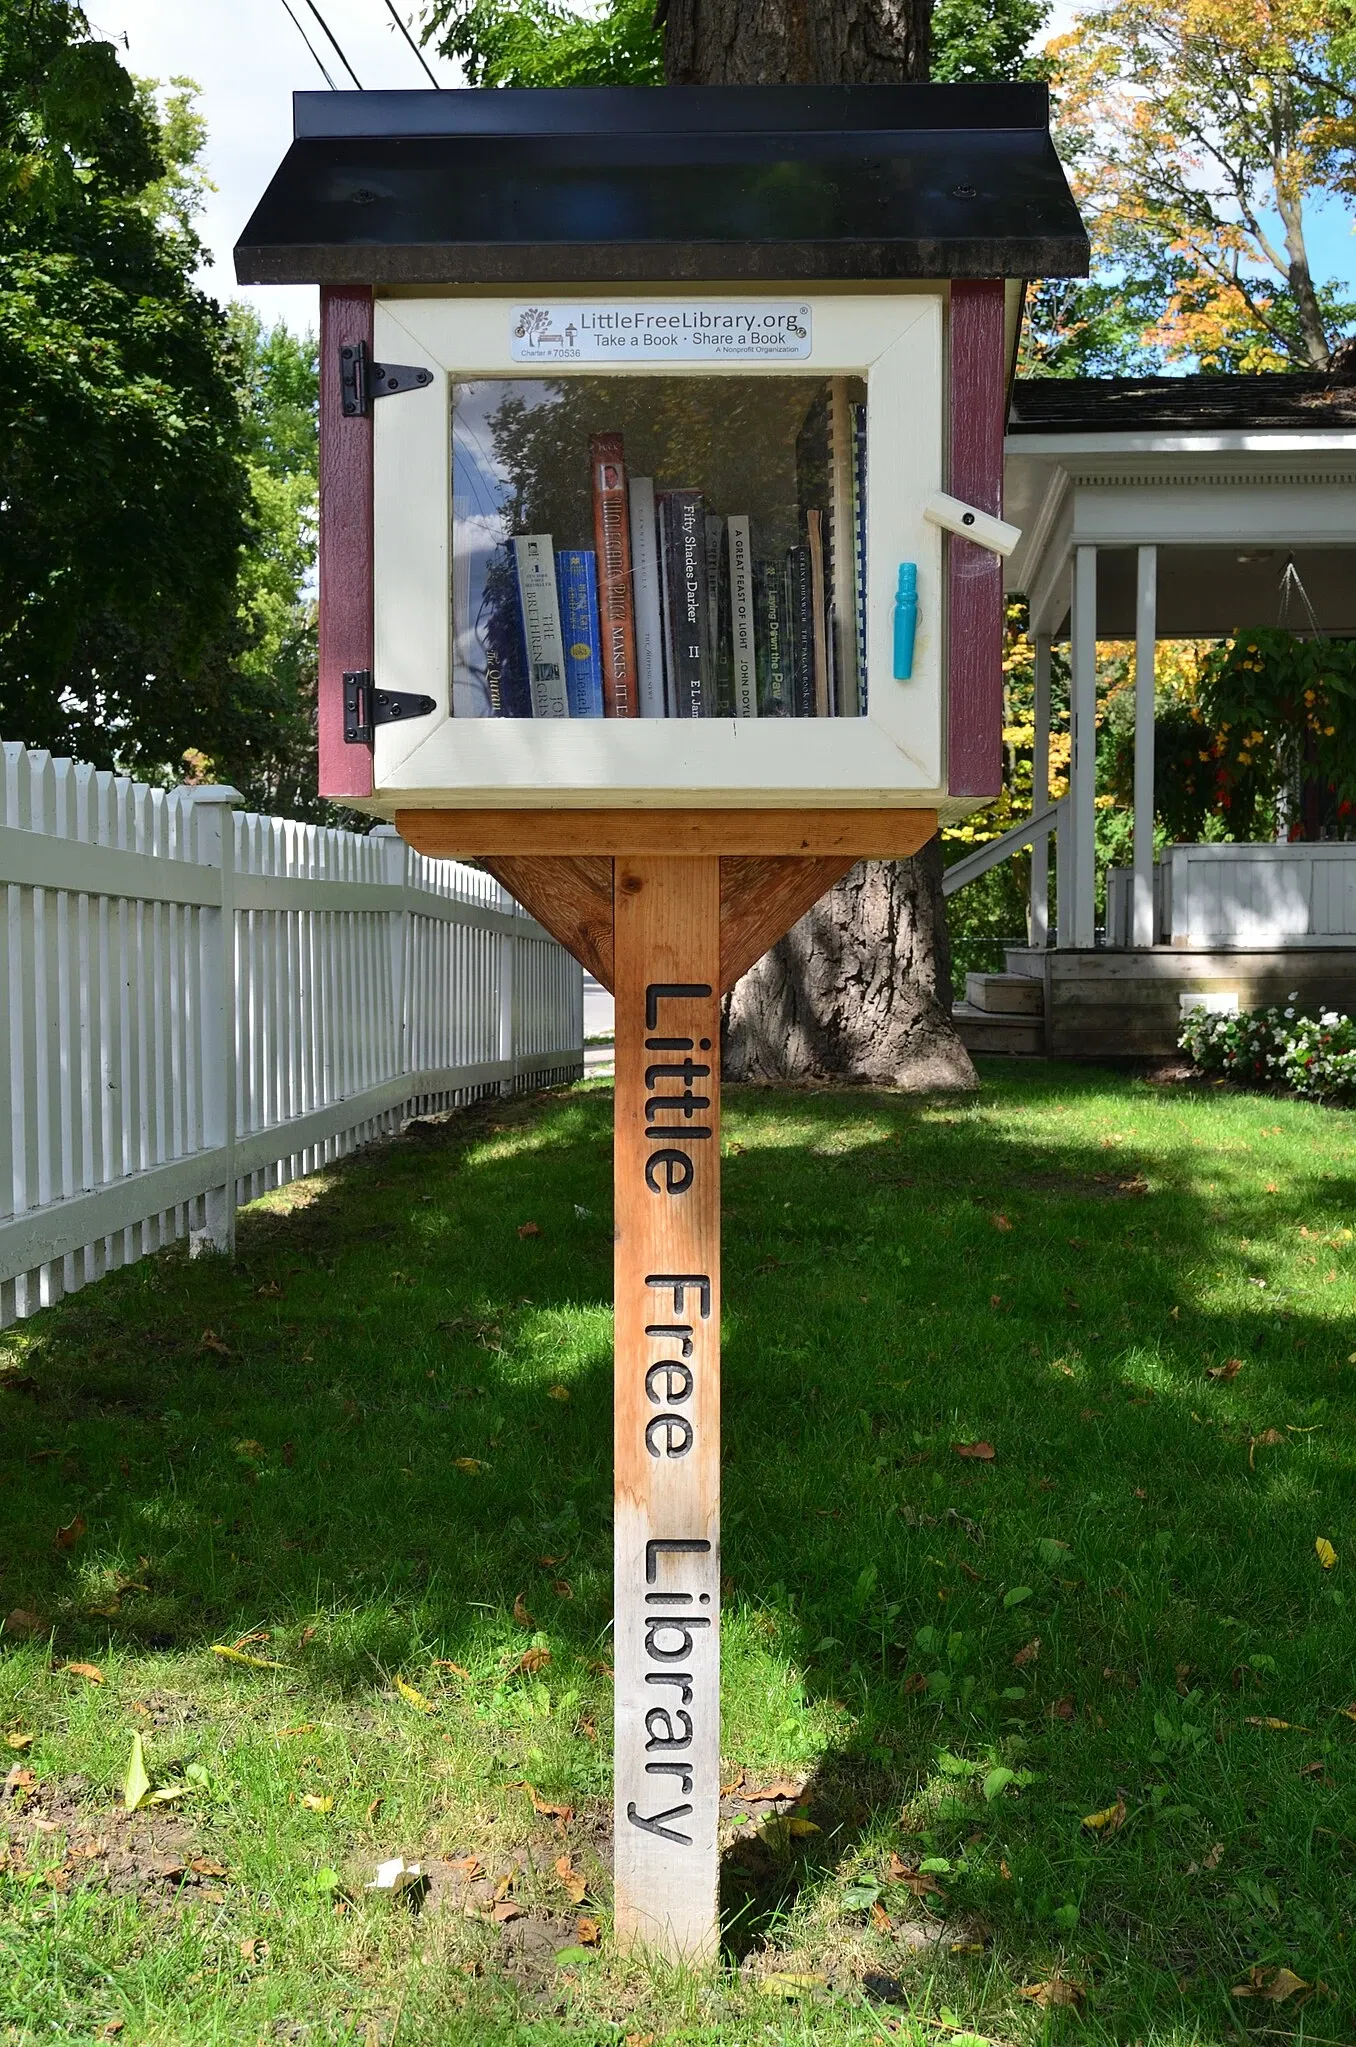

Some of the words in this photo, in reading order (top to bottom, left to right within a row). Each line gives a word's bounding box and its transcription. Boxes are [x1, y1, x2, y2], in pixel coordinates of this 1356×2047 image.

[581, 311, 798, 331] LittleFreeLibrary.org
[520, 349, 546, 357] Charter
[553, 348, 581, 358] 70536
[593, 333, 628, 346] Take
[630, 337, 639, 346] a
[643, 333, 678, 346] Book
[692, 332, 734, 345] Share
[737, 335, 746, 345] a
[751, 331, 786, 345] Book
[722, 346, 754, 354] Nonprofit
[755, 345, 799, 354] Organization
[681, 504, 696, 534] Fifty
[735, 529, 743, 537] A
[684, 535, 698, 579] Shades
[735, 540, 745, 571] GREAT
[608, 583, 626, 621] PUCK
[686, 581, 699, 624] Darker
[737, 574, 746, 603] FEAST
[526, 592, 543, 662] BRETHREN
[542, 613, 556, 640] THE
[738, 606, 747, 620] OF
[739, 622, 748, 650] LIGHT
[770, 621, 780, 650] Down
[611, 626, 627, 680] MAKES
[770, 652, 781, 669] the
[690, 679, 701, 688] E
[740, 659, 749, 687] JOHN
[485, 669, 502, 710] Quran
[576, 671, 592, 715] beach
[615, 683, 628, 701] IT
[691, 689, 701, 697] L
[644, 983, 713, 1195] Little
[644, 1274, 711, 1459] Free
[627, 1538, 711, 1847] Library
